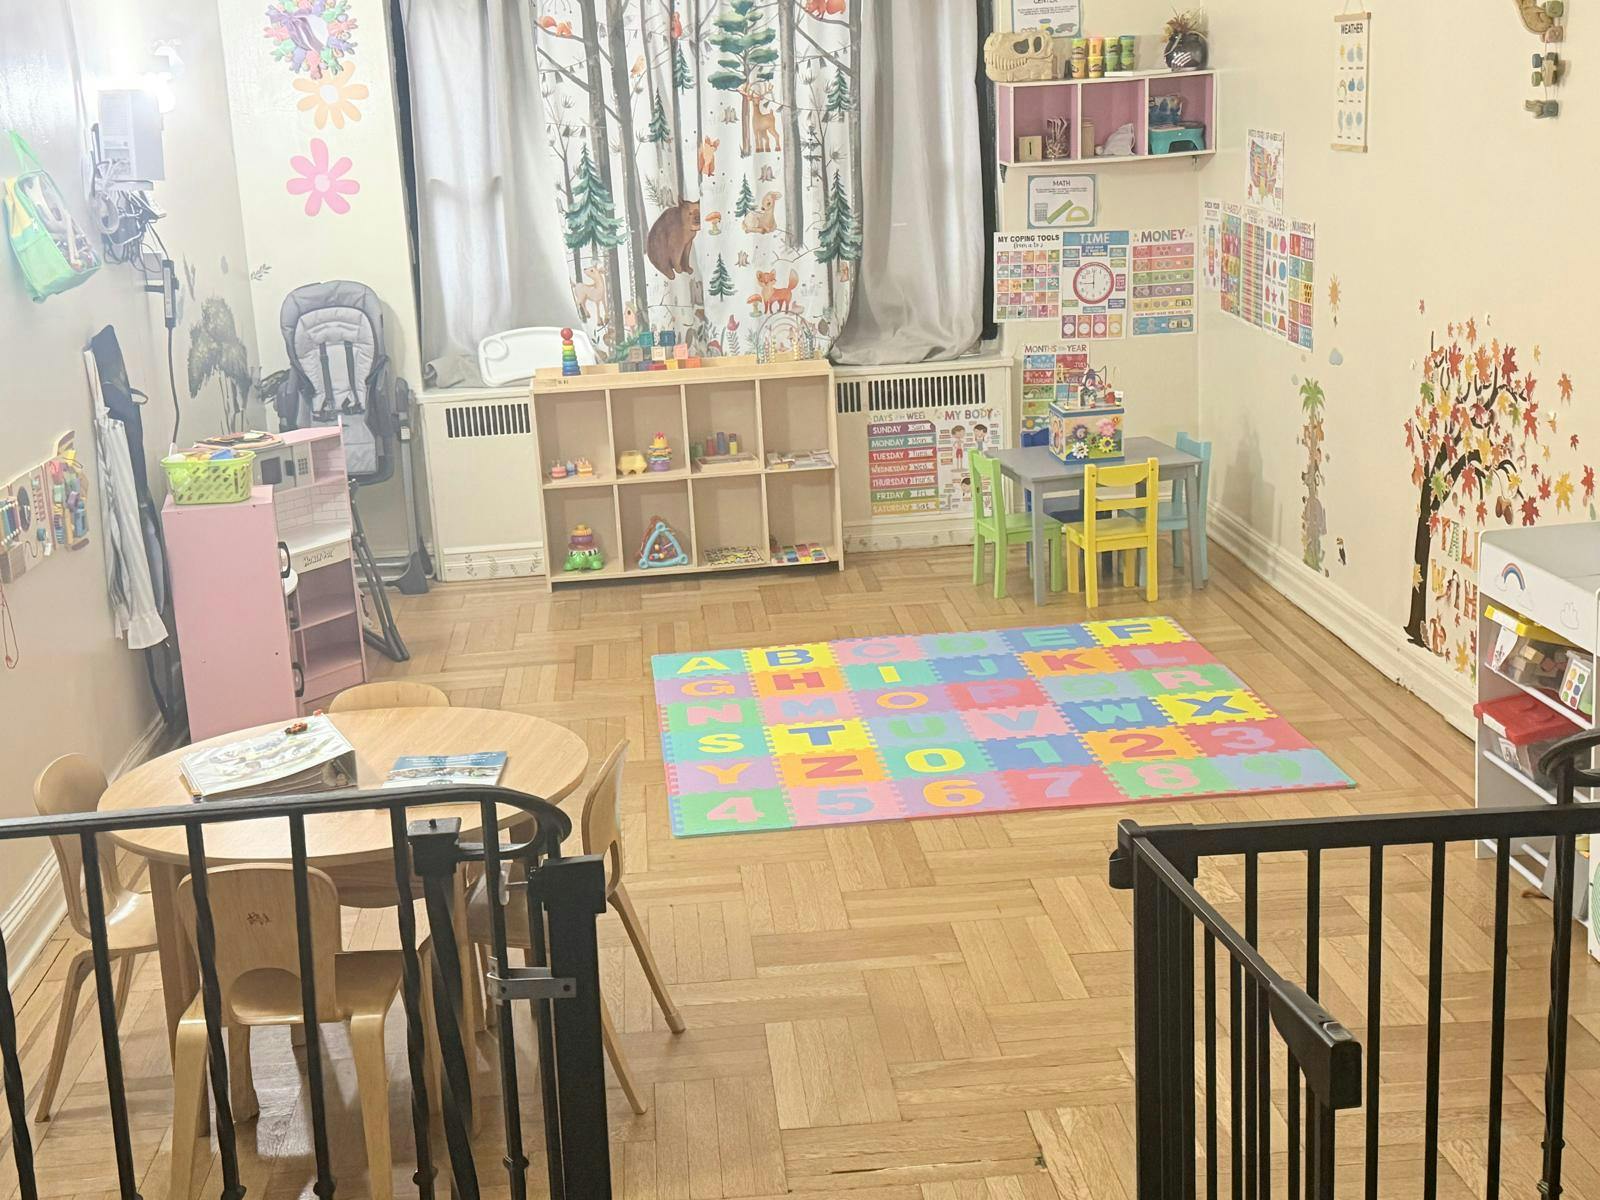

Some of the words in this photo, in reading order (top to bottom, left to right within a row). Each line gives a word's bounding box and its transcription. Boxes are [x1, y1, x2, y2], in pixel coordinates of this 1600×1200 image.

[1341, 23, 1363, 34] WEATHER
[1080, 232, 1110, 244] TIME
[1141, 229, 1185, 242] MONEY
[1024, 344, 1057, 353] MONTHS
[1066, 344, 1087, 352] YEAR
[873, 414, 893, 422] DAYS
[945, 410, 961, 420] MY
[965, 408, 993, 420] BODY
[872, 425, 901, 434] SUNDAY
[872, 439, 904, 448] MONDAY
[872, 452, 905, 460] TUESDAY
[871, 464, 908, 473] WEDNESDAY
[872, 478, 909, 487] THURSDAY
[876, 492, 904, 500] FRIDAY
[872, 504, 910, 513] SATURDAY
[677, 656, 730, 674] A
[765, 649, 814, 667] B
[852, 642, 900, 659] C
[937, 636, 989, 654] D
[1022, 628, 1079, 647] E
[1111, 624, 1153, 640] F
[681, 680, 736, 696] G
[772, 672, 825, 690] H
[878, 666, 902, 683] I
[963, 658, 999, 676] J
[1041, 654, 1096, 671] K
[1131, 650, 1187, 666] L
[686, 704, 742, 726] N
[779, 698, 838, 718] M
[876, 692, 928, 710] O
[967, 684, 1020, 704] P
[1152, 670, 1214, 690] R
[698, 734, 744, 753] S
[788, 725, 846, 746] T
[888, 716, 946, 738] U
[982, 710, 1040, 732] V
[1080, 702, 1144, 724] W
[1177, 696, 1248, 717] X
[696, 762, 752, 785] Y
[801, 754, 864, 780] Z
[1016, 740, 1062, 764] 1
[1110, 734, 1177, 758] 2
[1210, 726, 1275, 750] 3
[706, 796, 764, 823] 4
[817, 788, 875, 816] 5
[922, 780, 985, 808] 6
[1028, 770, 1083, 798] 7
[1136, 764, 1200, 790] 8
